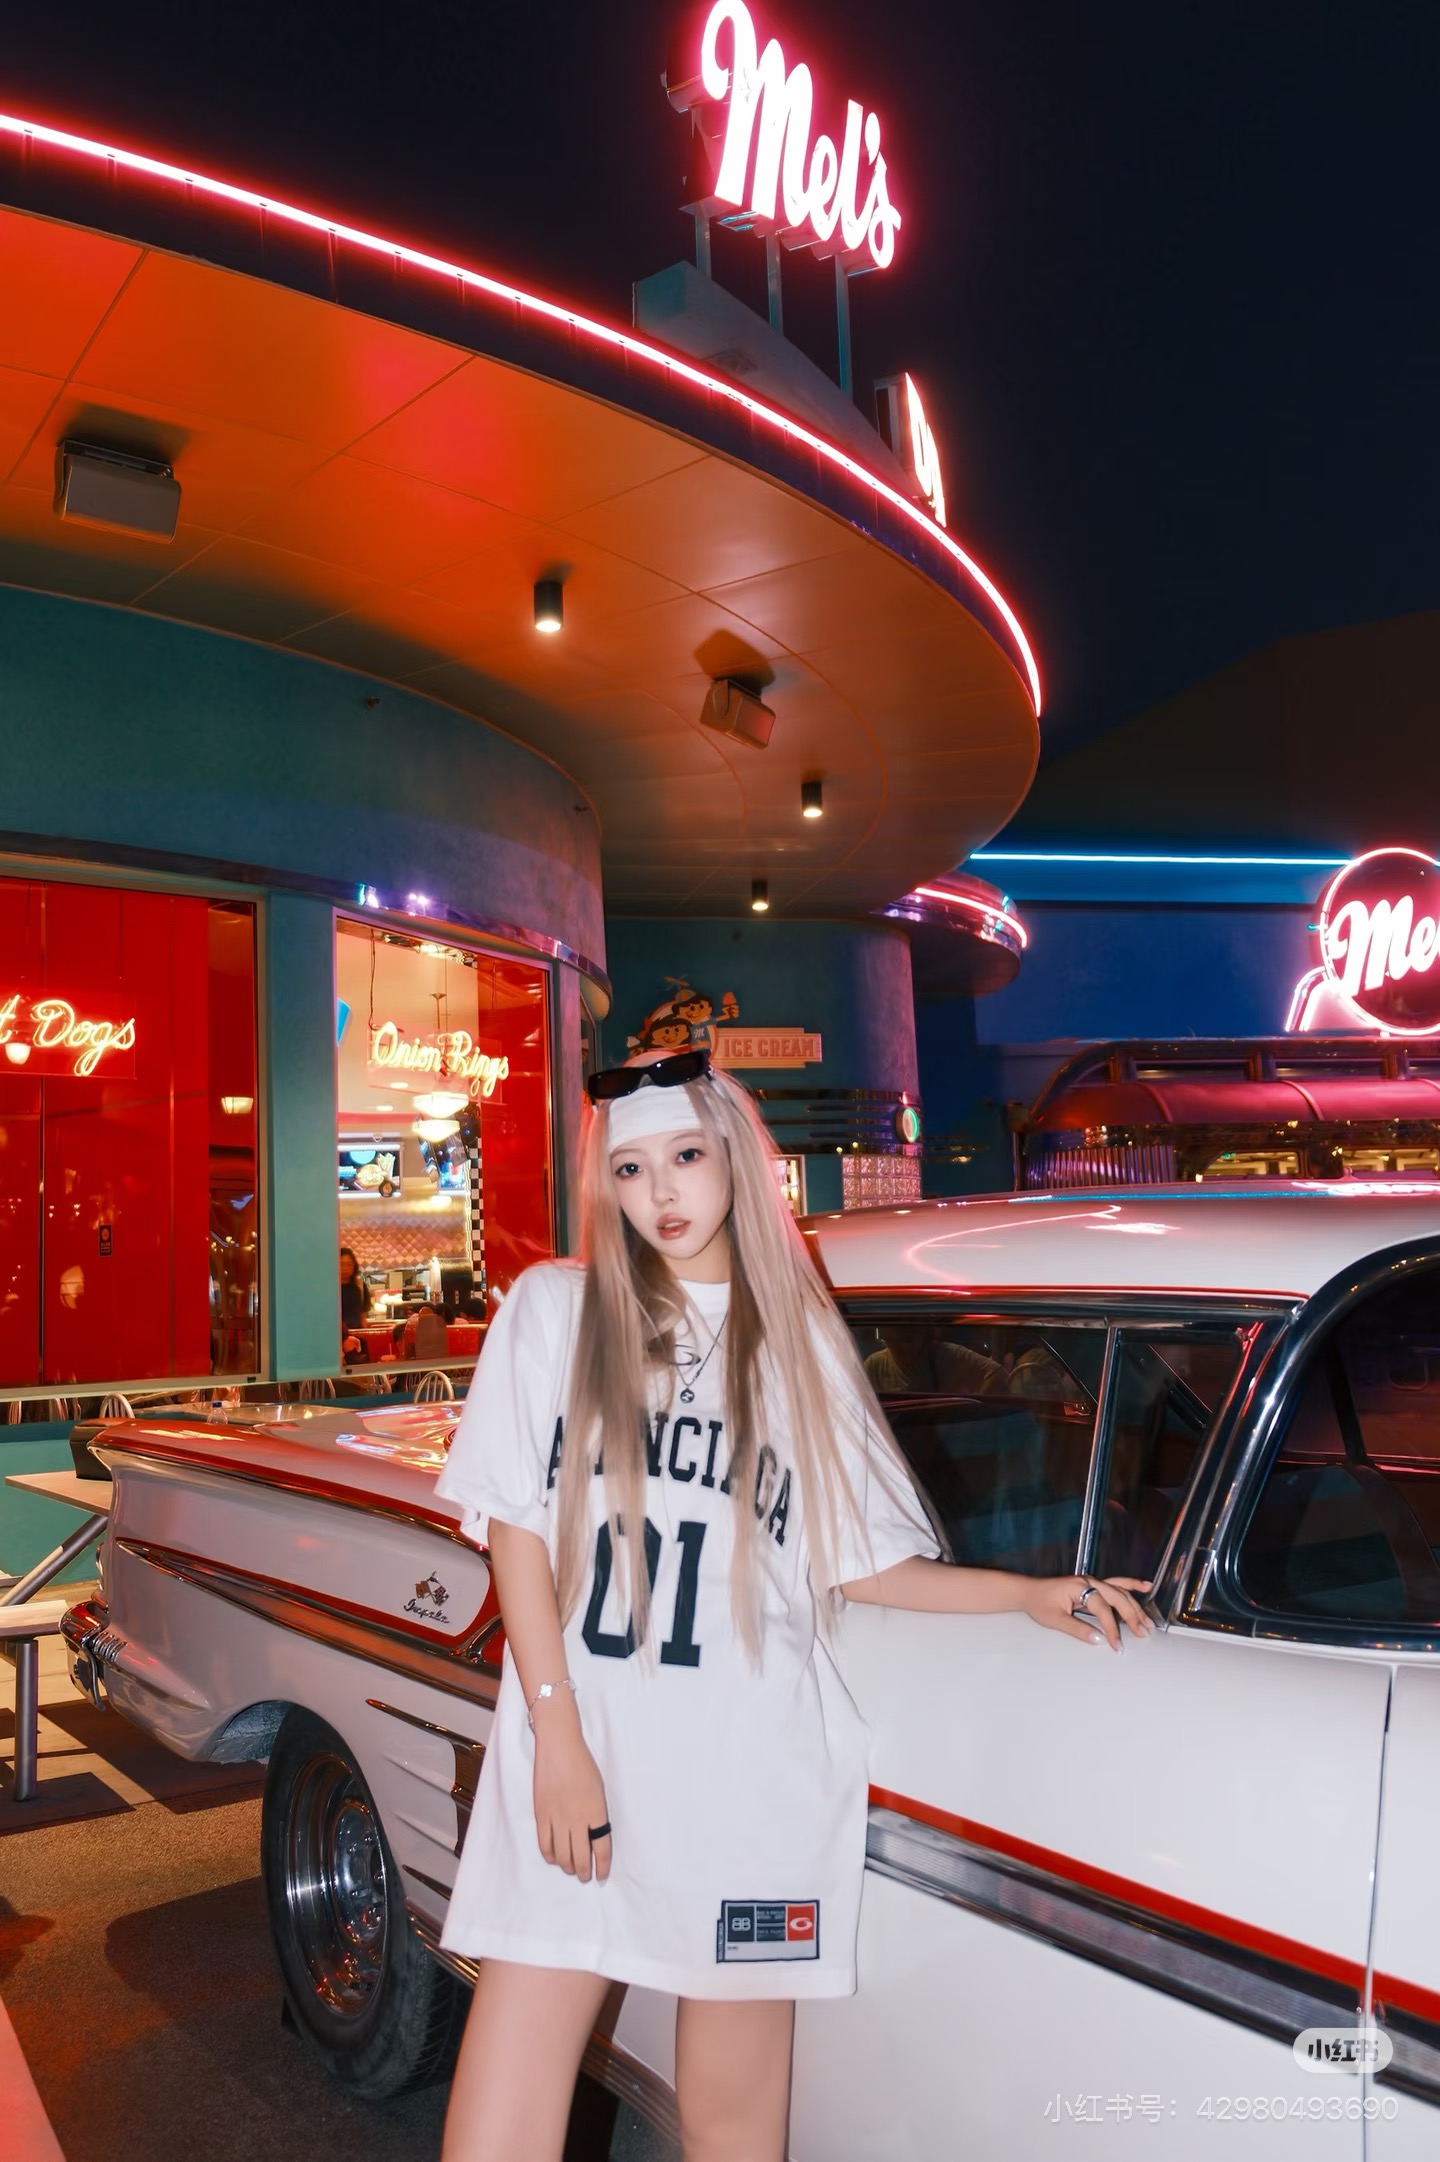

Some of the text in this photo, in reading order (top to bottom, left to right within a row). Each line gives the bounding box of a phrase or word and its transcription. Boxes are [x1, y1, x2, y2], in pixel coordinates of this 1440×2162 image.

[701, 0, 901, 269] Mel's
[1325, 894, 1440, 997] Me
[31, 999, 136, 1077] Dogs
[373, 1021, 509, 1097] Onion Rings
[723, 1038, 815, 1058] ICE CREAM
[581, 1516, 707, 1668] 01
